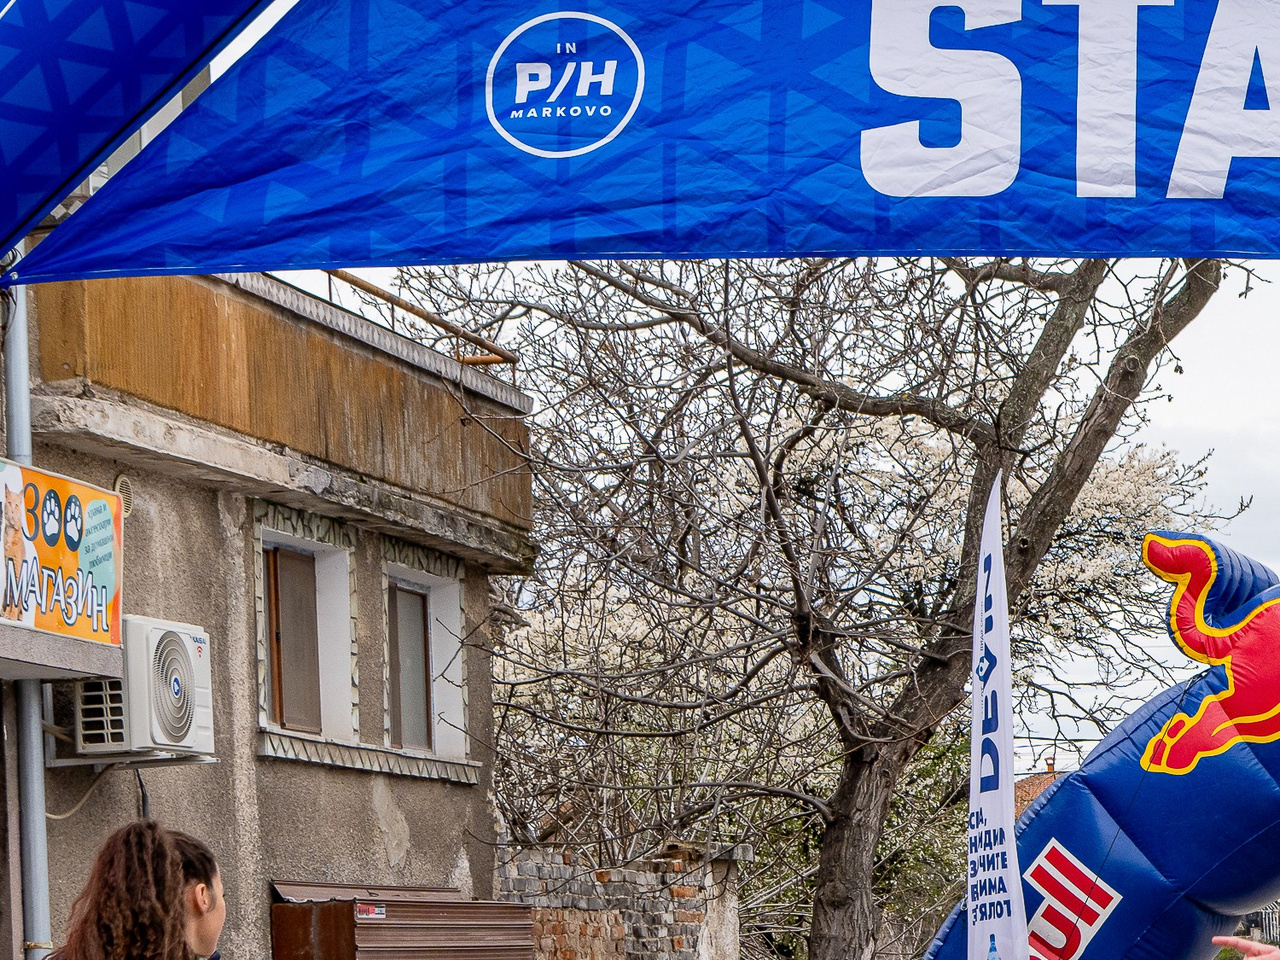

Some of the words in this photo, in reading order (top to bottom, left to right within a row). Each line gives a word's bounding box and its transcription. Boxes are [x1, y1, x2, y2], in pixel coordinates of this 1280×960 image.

[556, 43, 577, 54] IN
[515, 60, 618, 104] P/H
[510, 105, 612, 119] MARKOVO
[6, 556, 109, 633] МАГАЗИН
